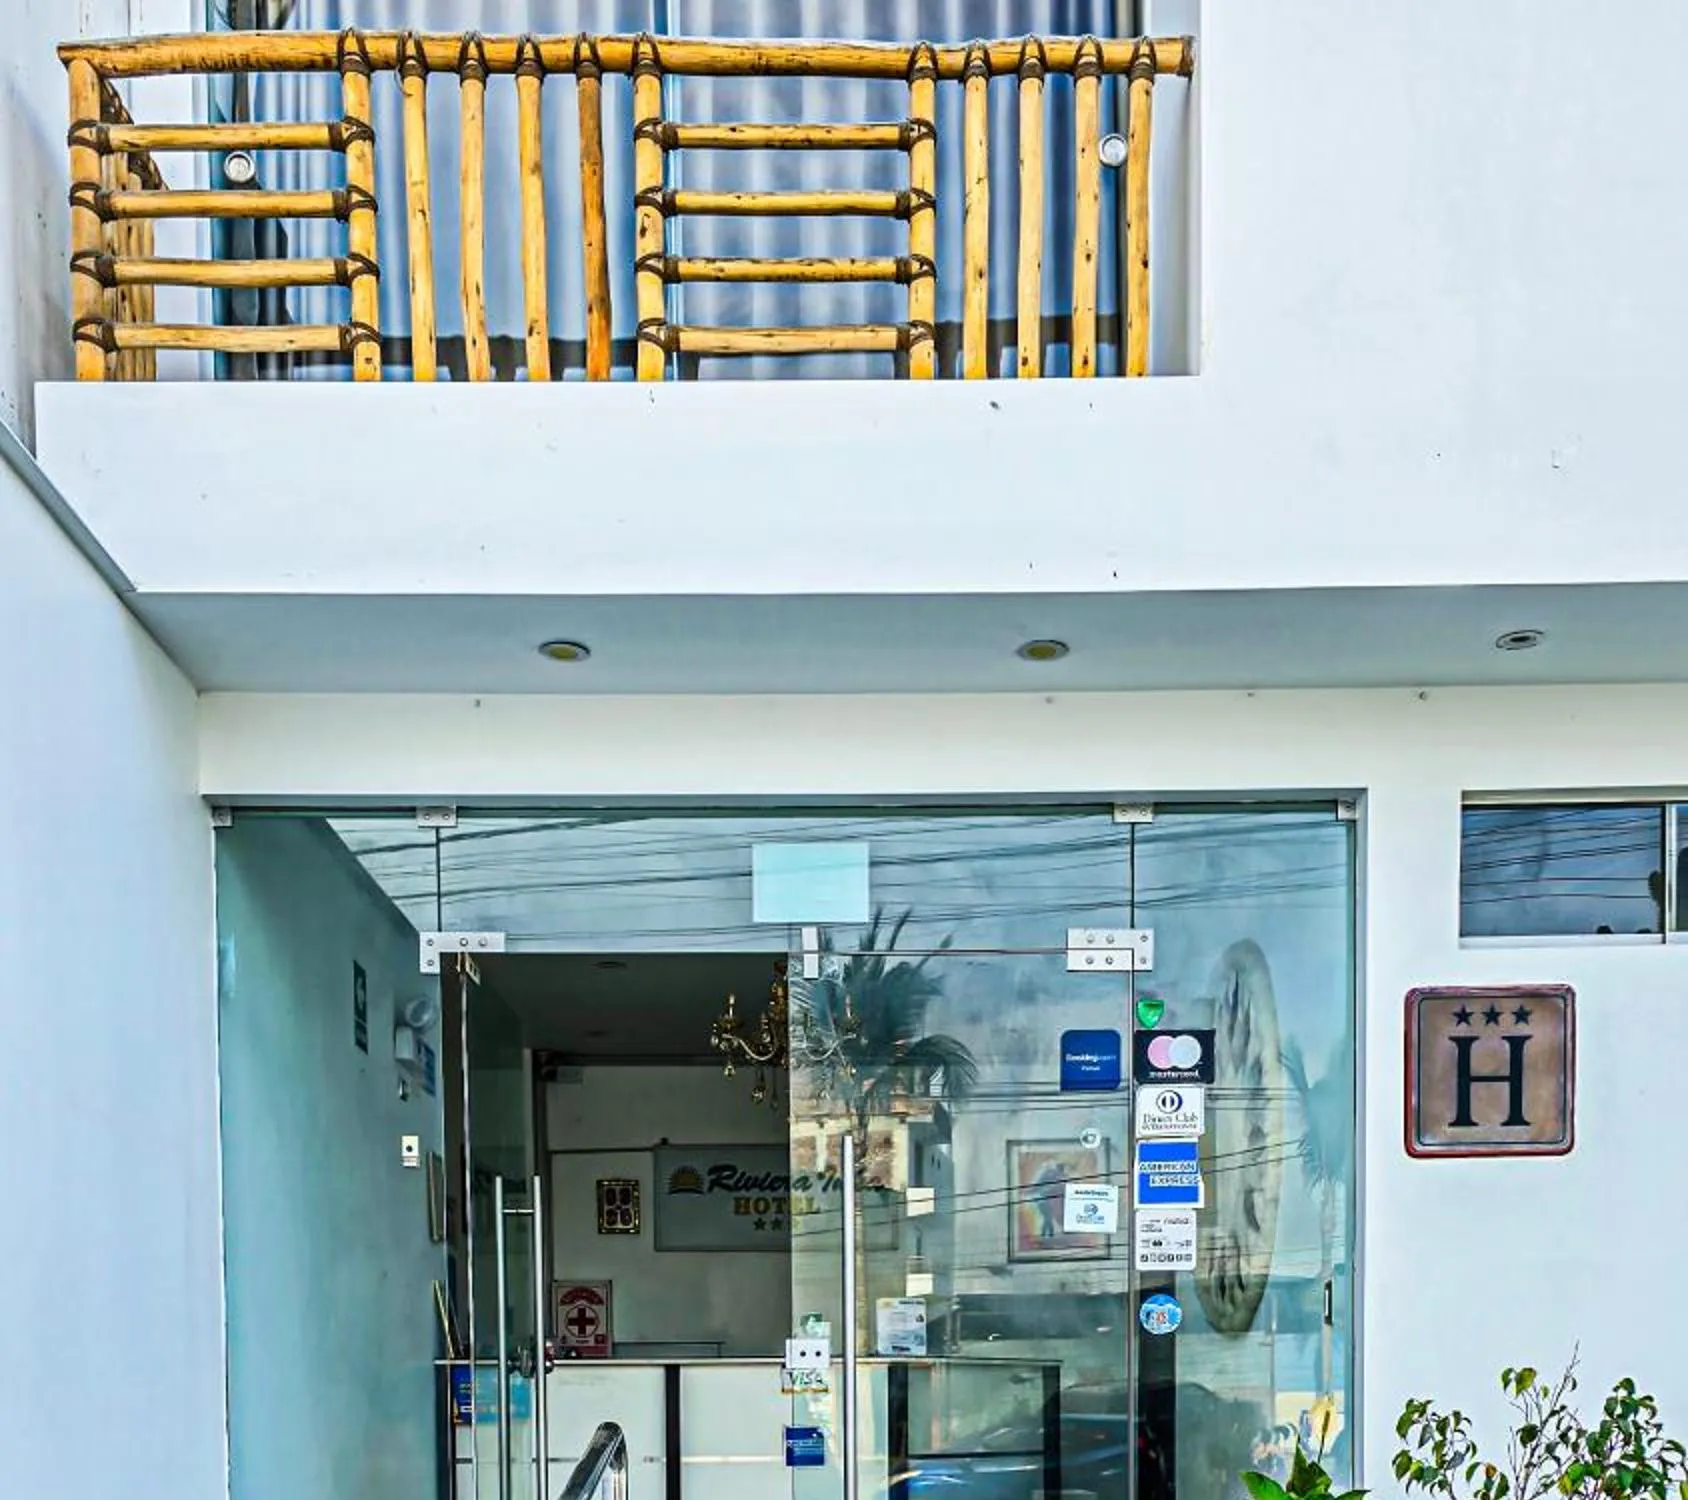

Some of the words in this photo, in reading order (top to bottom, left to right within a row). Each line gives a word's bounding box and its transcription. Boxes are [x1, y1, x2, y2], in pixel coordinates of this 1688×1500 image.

[1447, 1034, 1533, 1127] H
[1140, 1162, 1196, 1171] AMERICAN
[706, 1164, 813, 1193] Riviera
[1151, 1176, 1200, 1185] EXPRESS
[733, 1196, 817, 1216] HOTEL
